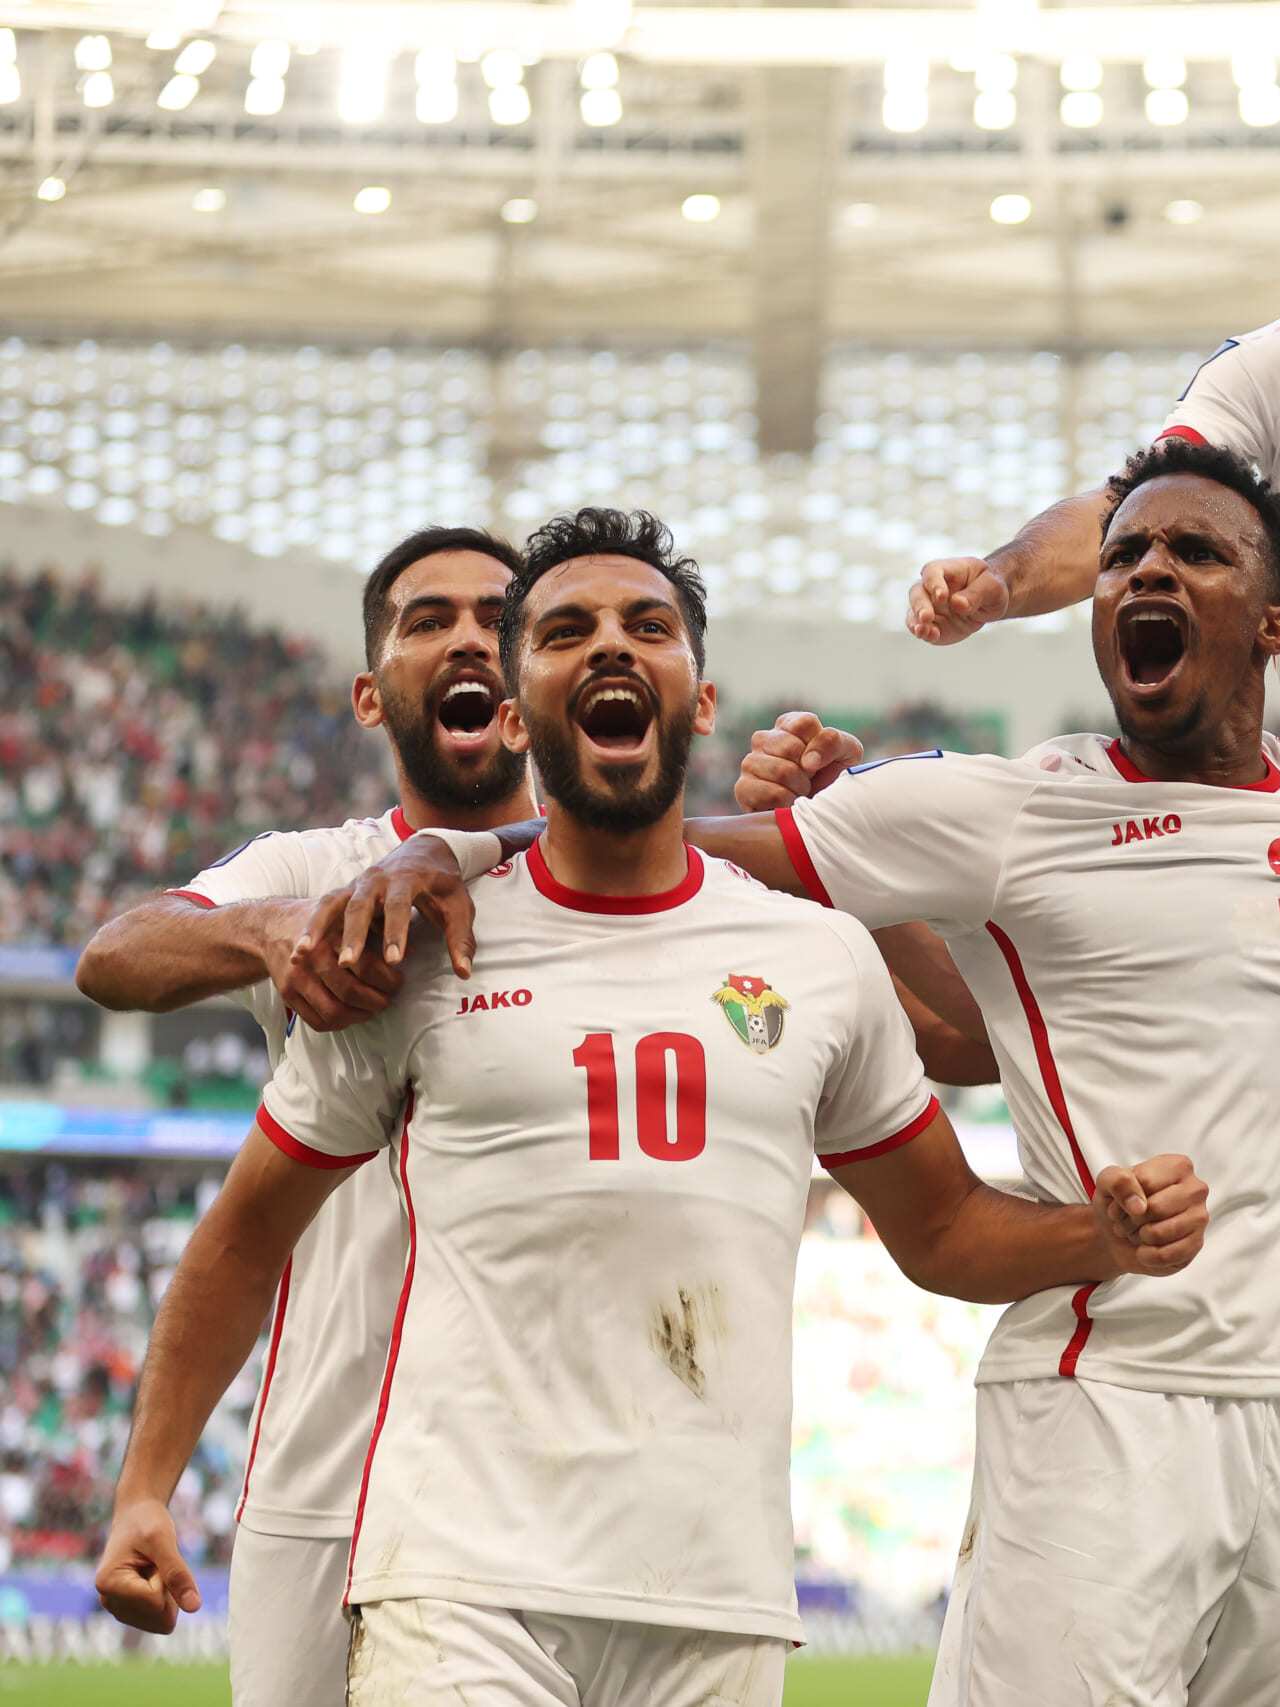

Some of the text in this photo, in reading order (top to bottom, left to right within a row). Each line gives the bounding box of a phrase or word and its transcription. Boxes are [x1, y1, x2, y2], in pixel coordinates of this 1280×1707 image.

[1111, 813, 1182, 846] JAKO
[456, 988, 533, 1016] JAKO
[751, 1037, 767, 1046] JFA
[572, 1031, 707, 1162] 10
